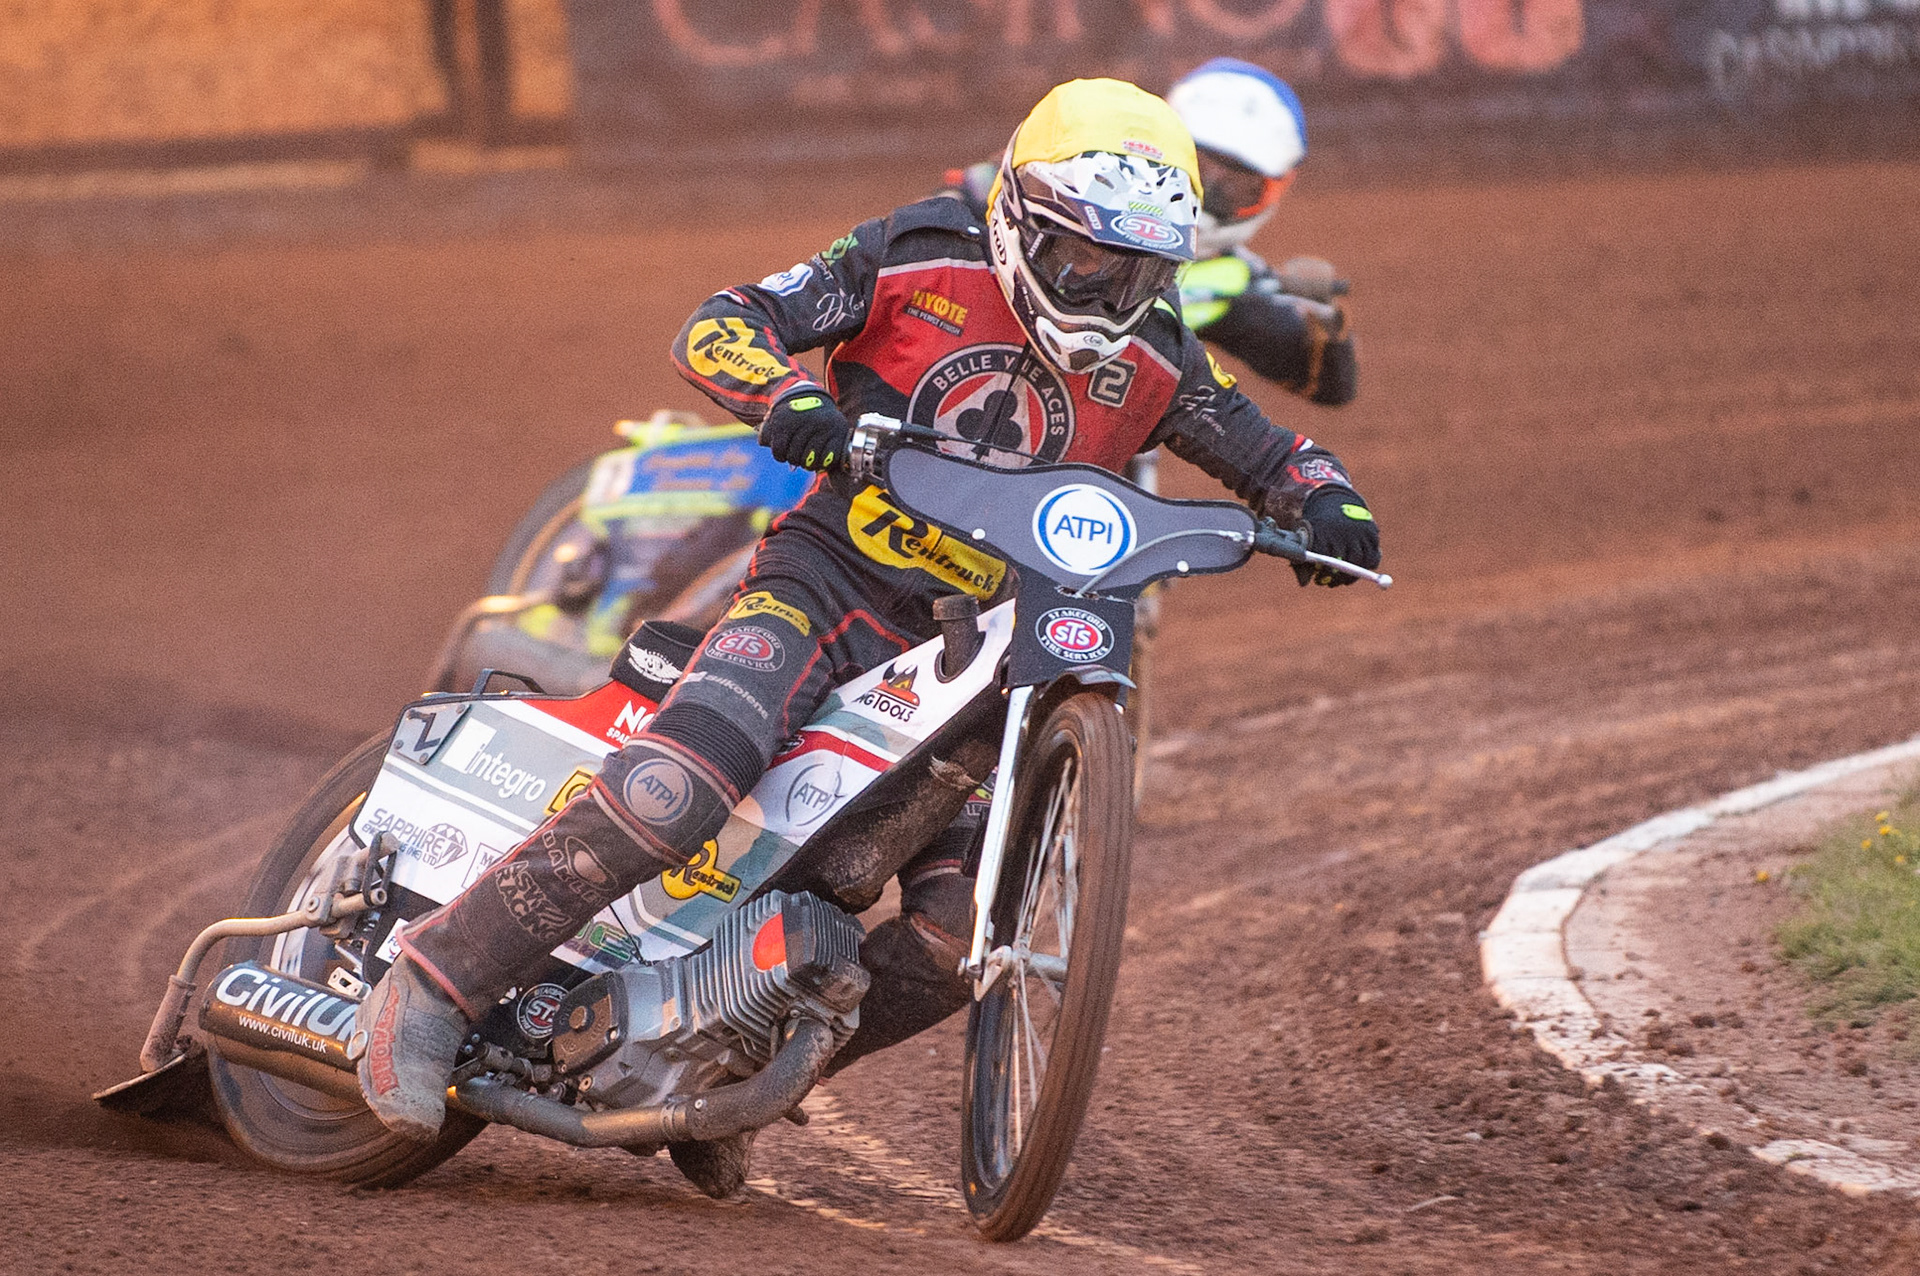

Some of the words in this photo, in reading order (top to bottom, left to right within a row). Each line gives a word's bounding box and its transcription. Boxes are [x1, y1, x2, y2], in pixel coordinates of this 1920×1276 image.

[1126, 218, 1170, 239] STS
[932, 354, 992, 391] BELLE
[1004, 355, 1044, 382] VUE
[1041, 386, 1065, 436] ACES
[1097, 363, 1127, 400] 2
[1053, 514, 1114, 545] ATPI
[1047, 609, 1107, 632] STAKEFORD
[1053, 621, 1092, 648] STS
[722, 633, 764, 655] STS
[465, 743, 547, 801] integro
[637, 774, 678, 809] ATPI
[794, 782, 833, 811] ATPI
[368, 807, 446, 857] SAPPHIRE
[422, 852, 438, 867] LTD
[527, 1000, 556, 1023] ST
[238, 1014, 328, 1054] www.civiluk.uk
